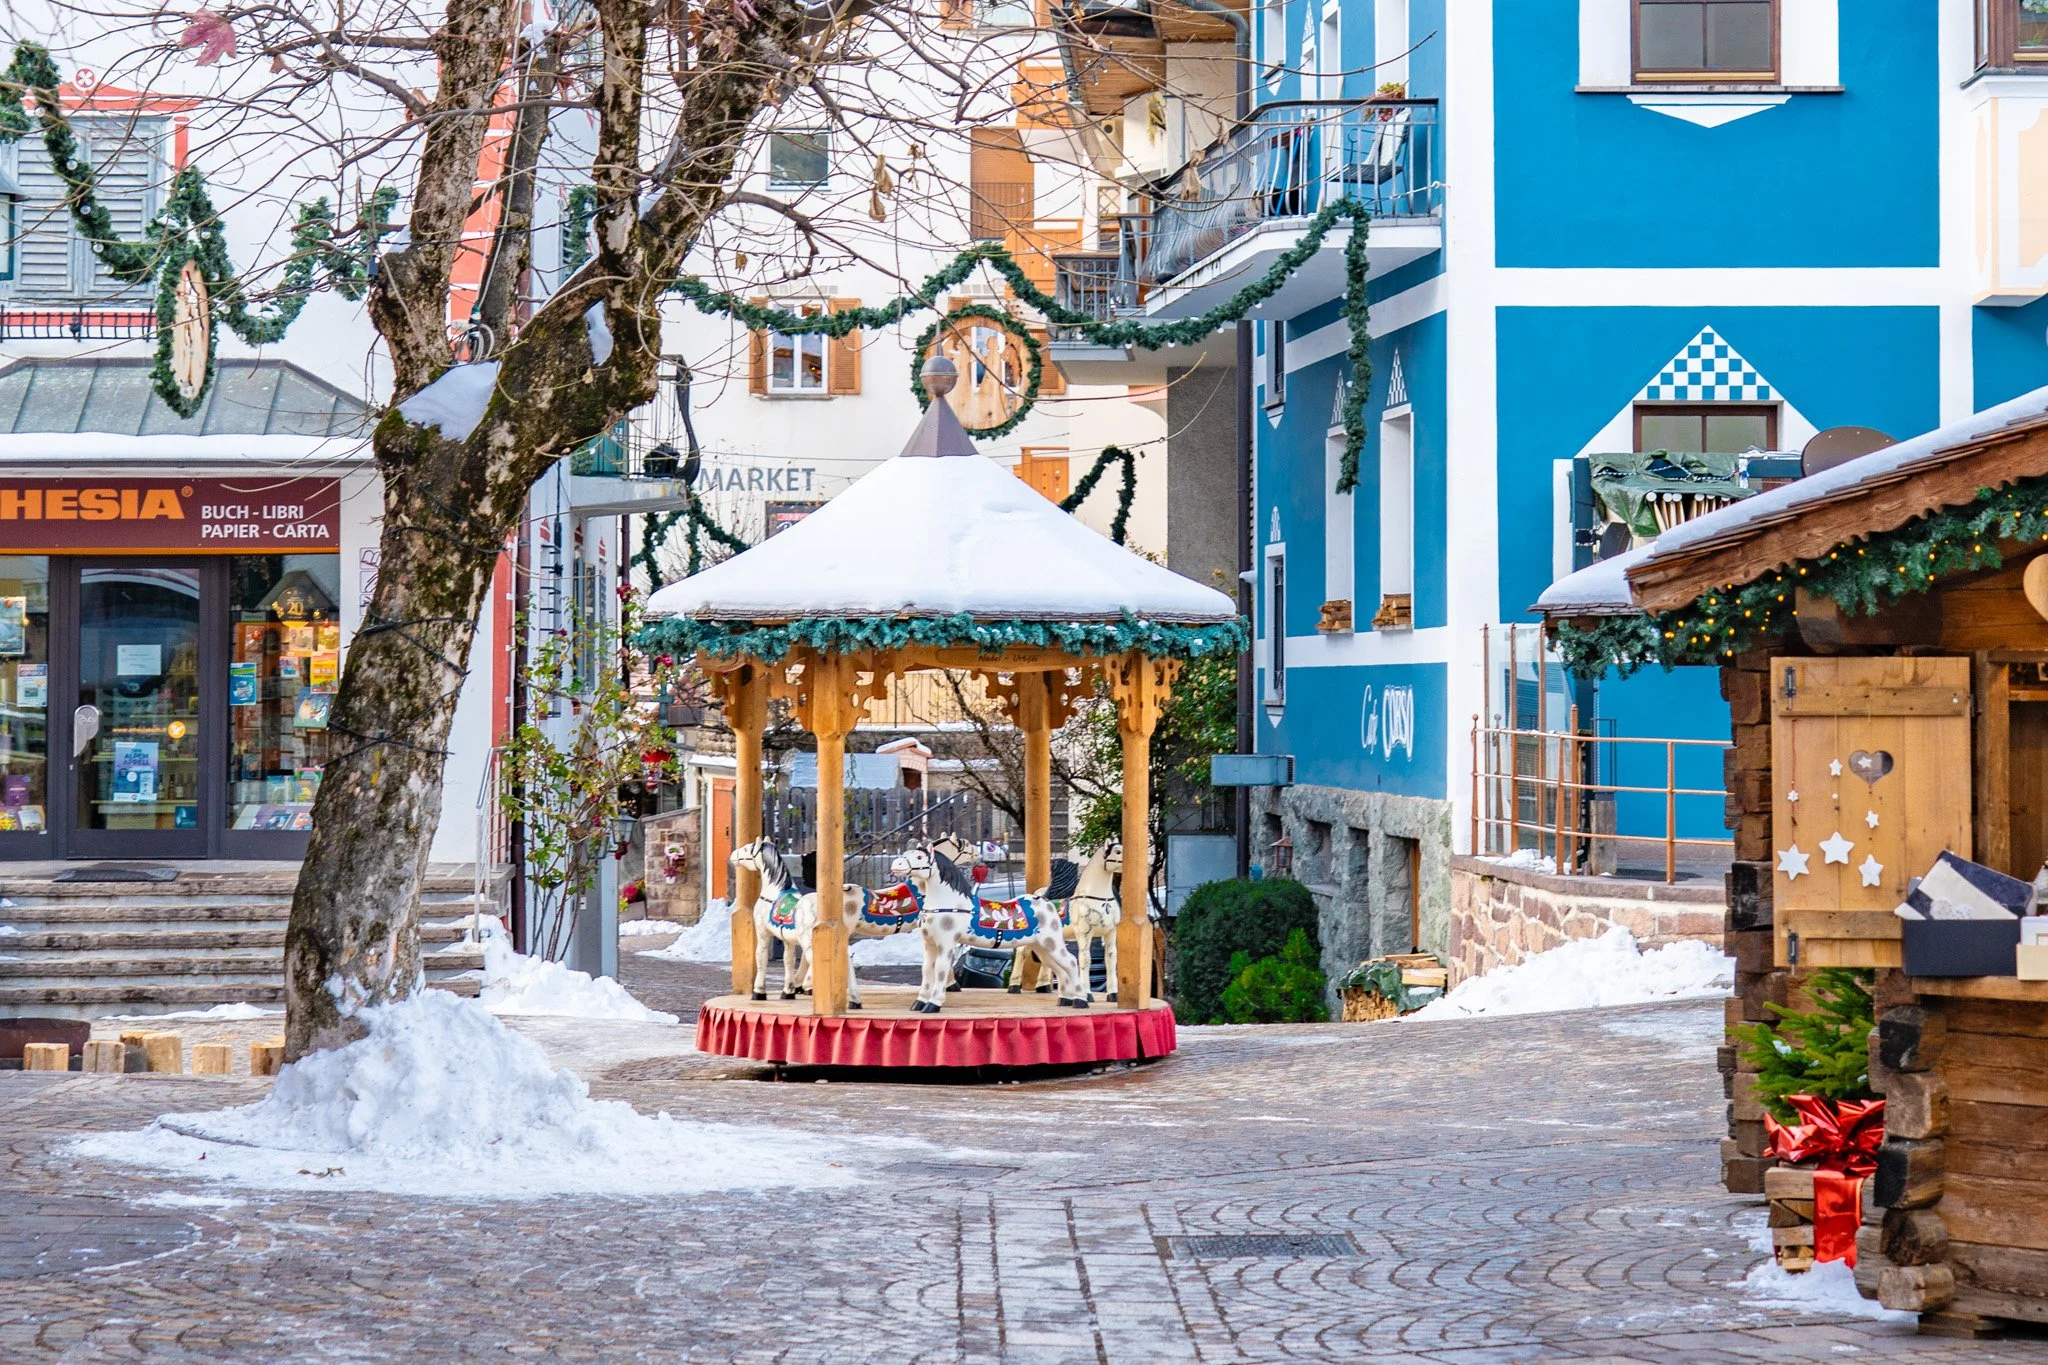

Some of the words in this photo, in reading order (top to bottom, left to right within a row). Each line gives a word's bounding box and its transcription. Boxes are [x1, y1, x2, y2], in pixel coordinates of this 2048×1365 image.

[699, 467, 816, 491] MARKET
[0, 488, 185, 521] HESIA
[201, 505, 249, 519] BUCH
[262, 505, 304, 519] LIBRI
[201, 524, 260, 538] PAPIER
[272, 524, 330, 538] CARTA
[1382, 684, 1415, 762] CORSO
